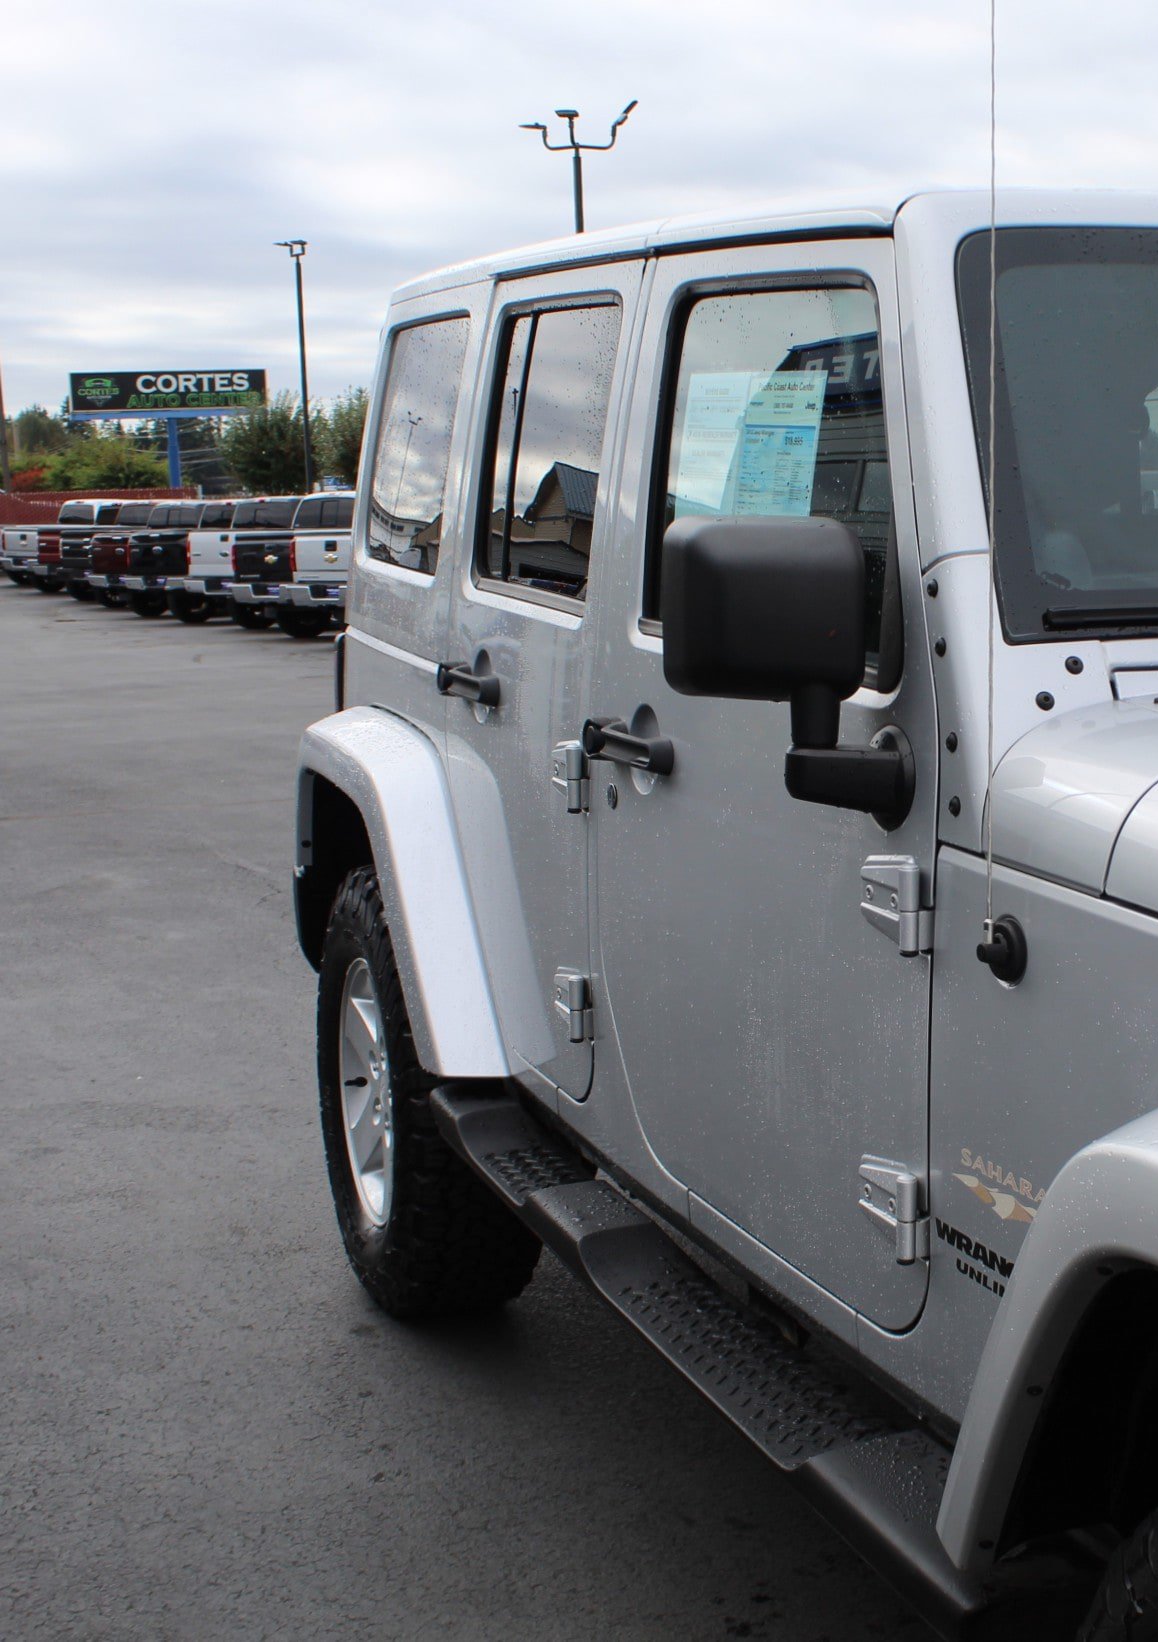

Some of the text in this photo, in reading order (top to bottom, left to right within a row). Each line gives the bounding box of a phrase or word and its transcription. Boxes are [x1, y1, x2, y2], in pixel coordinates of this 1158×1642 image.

[136, 372, 250, 394] CORTES
[126, 391, 263, 409] AUTO CENTER
[960, 1147, 1048, 1202] SAHARA
